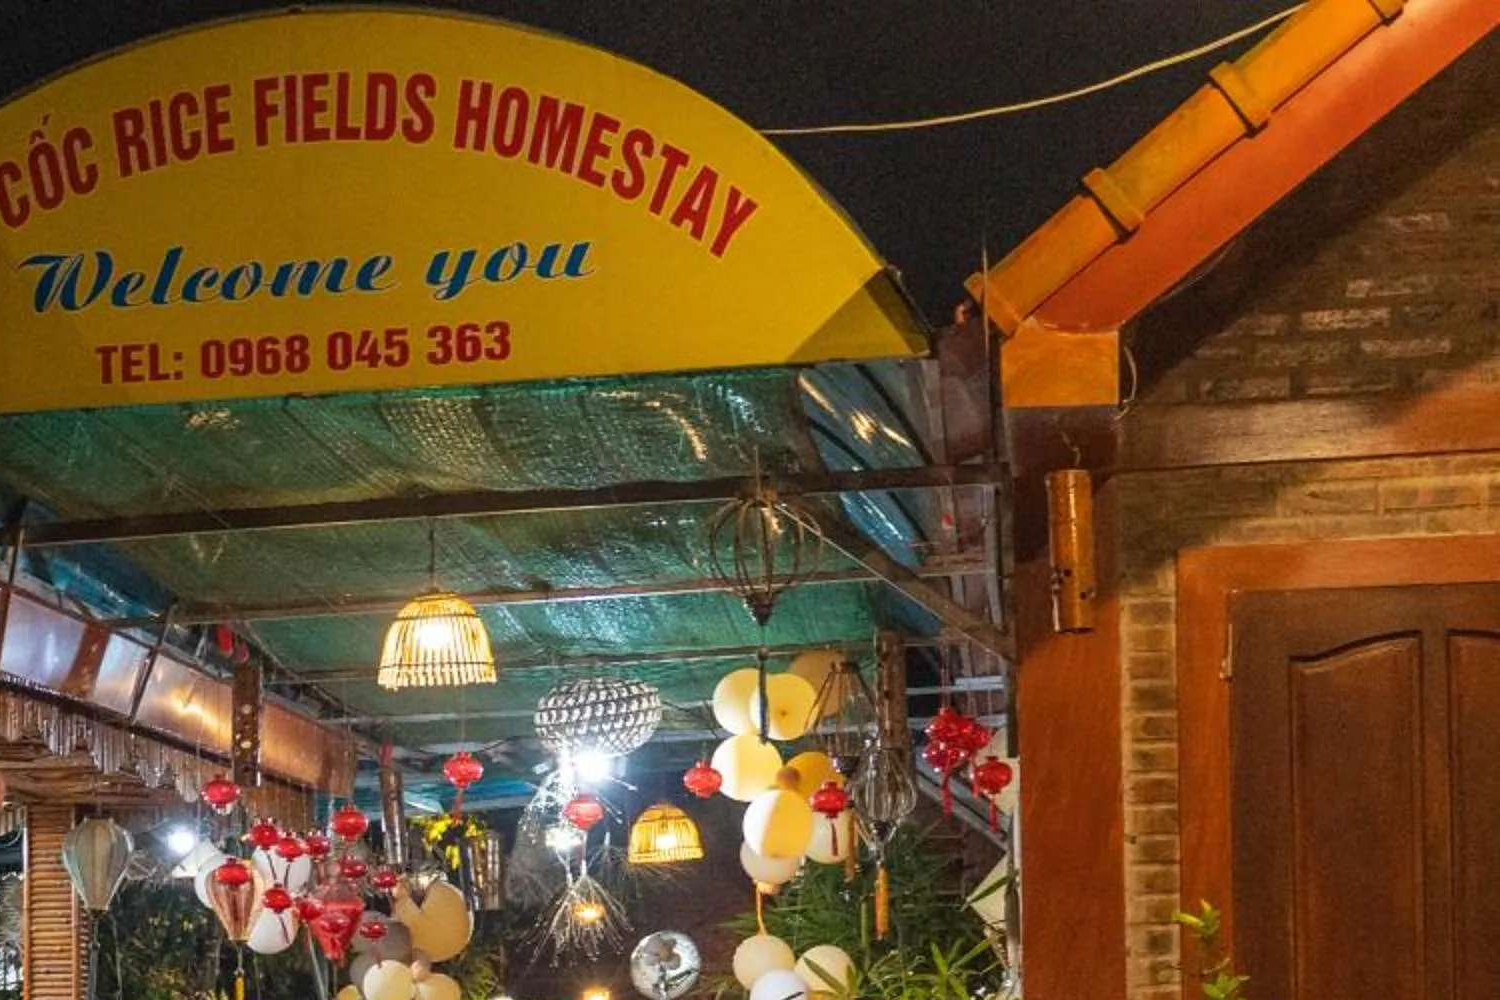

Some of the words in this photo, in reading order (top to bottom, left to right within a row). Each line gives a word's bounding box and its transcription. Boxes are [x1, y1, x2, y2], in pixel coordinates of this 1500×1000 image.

[115, 82, 234, 181] RICE
[253, 71, 437, 145] FIELDS
[455, 79, 760, 260] HOMESTAY
[17, 246, 396, 315] Welcome
[425, 239, 597, 301] you
[96, 344, 185, 386] TEL:
[199, 337, 311, 379] 0968
[326, 328, 410, 372] 045
[427, 321, 512, 364] 363
